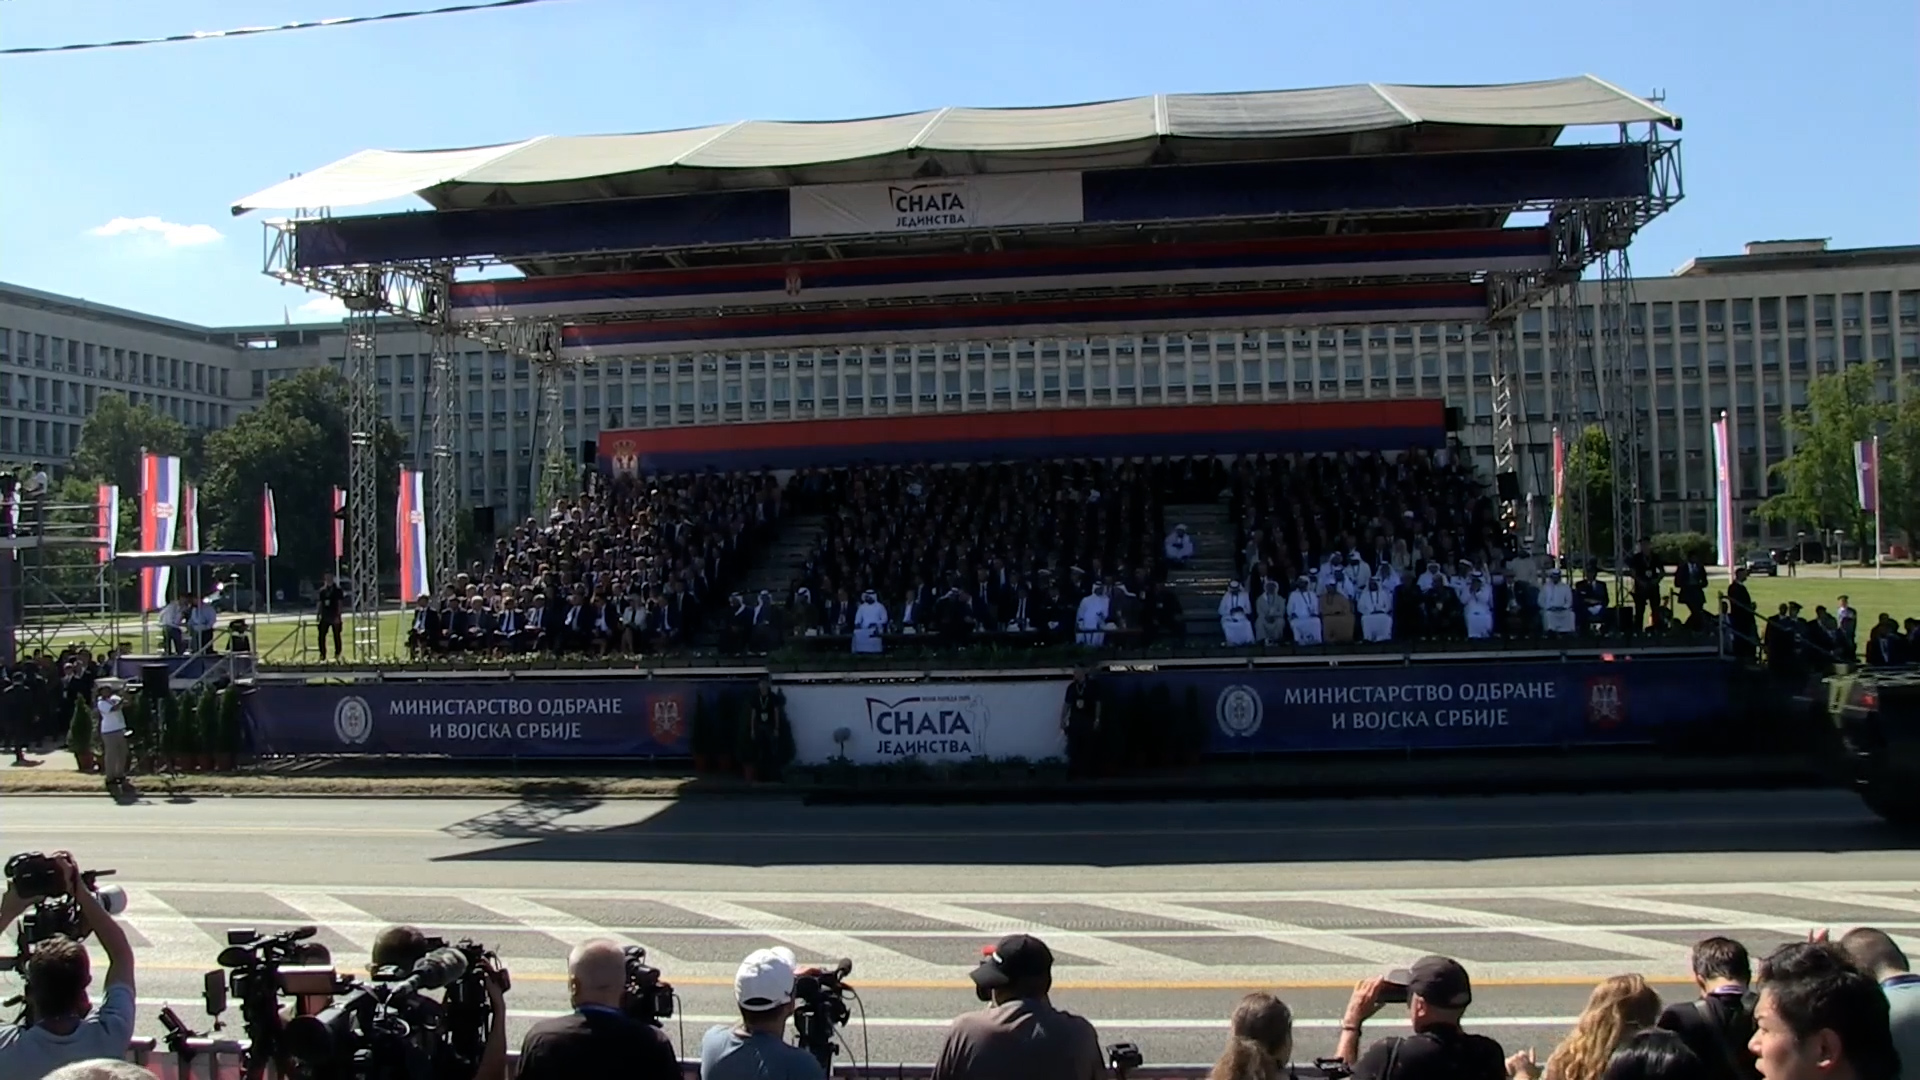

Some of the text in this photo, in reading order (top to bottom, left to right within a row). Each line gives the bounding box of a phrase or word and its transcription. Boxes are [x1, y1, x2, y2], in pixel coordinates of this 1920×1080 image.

[896, 193, 964, 212] СНАГА
[896, 215, 965, 227] ЈЕДИНСТВА
[1284, 682, 1556, 704] МИНИСТАРСТВО ОДБРАНЕ
[389, 698, 623, 716] МИНИСТАРСТВО ОДБРАНЕ
[876, 711, 971, 735] СНАГА
[1332, 708, 1509, 730] И ВОЈСКА СРБИЈЕ
[429, 722, 582, 740] И ВОЈСКА СРБИЈЕ
[876, 740, 971, 755] ЈЕДИНСТВА
